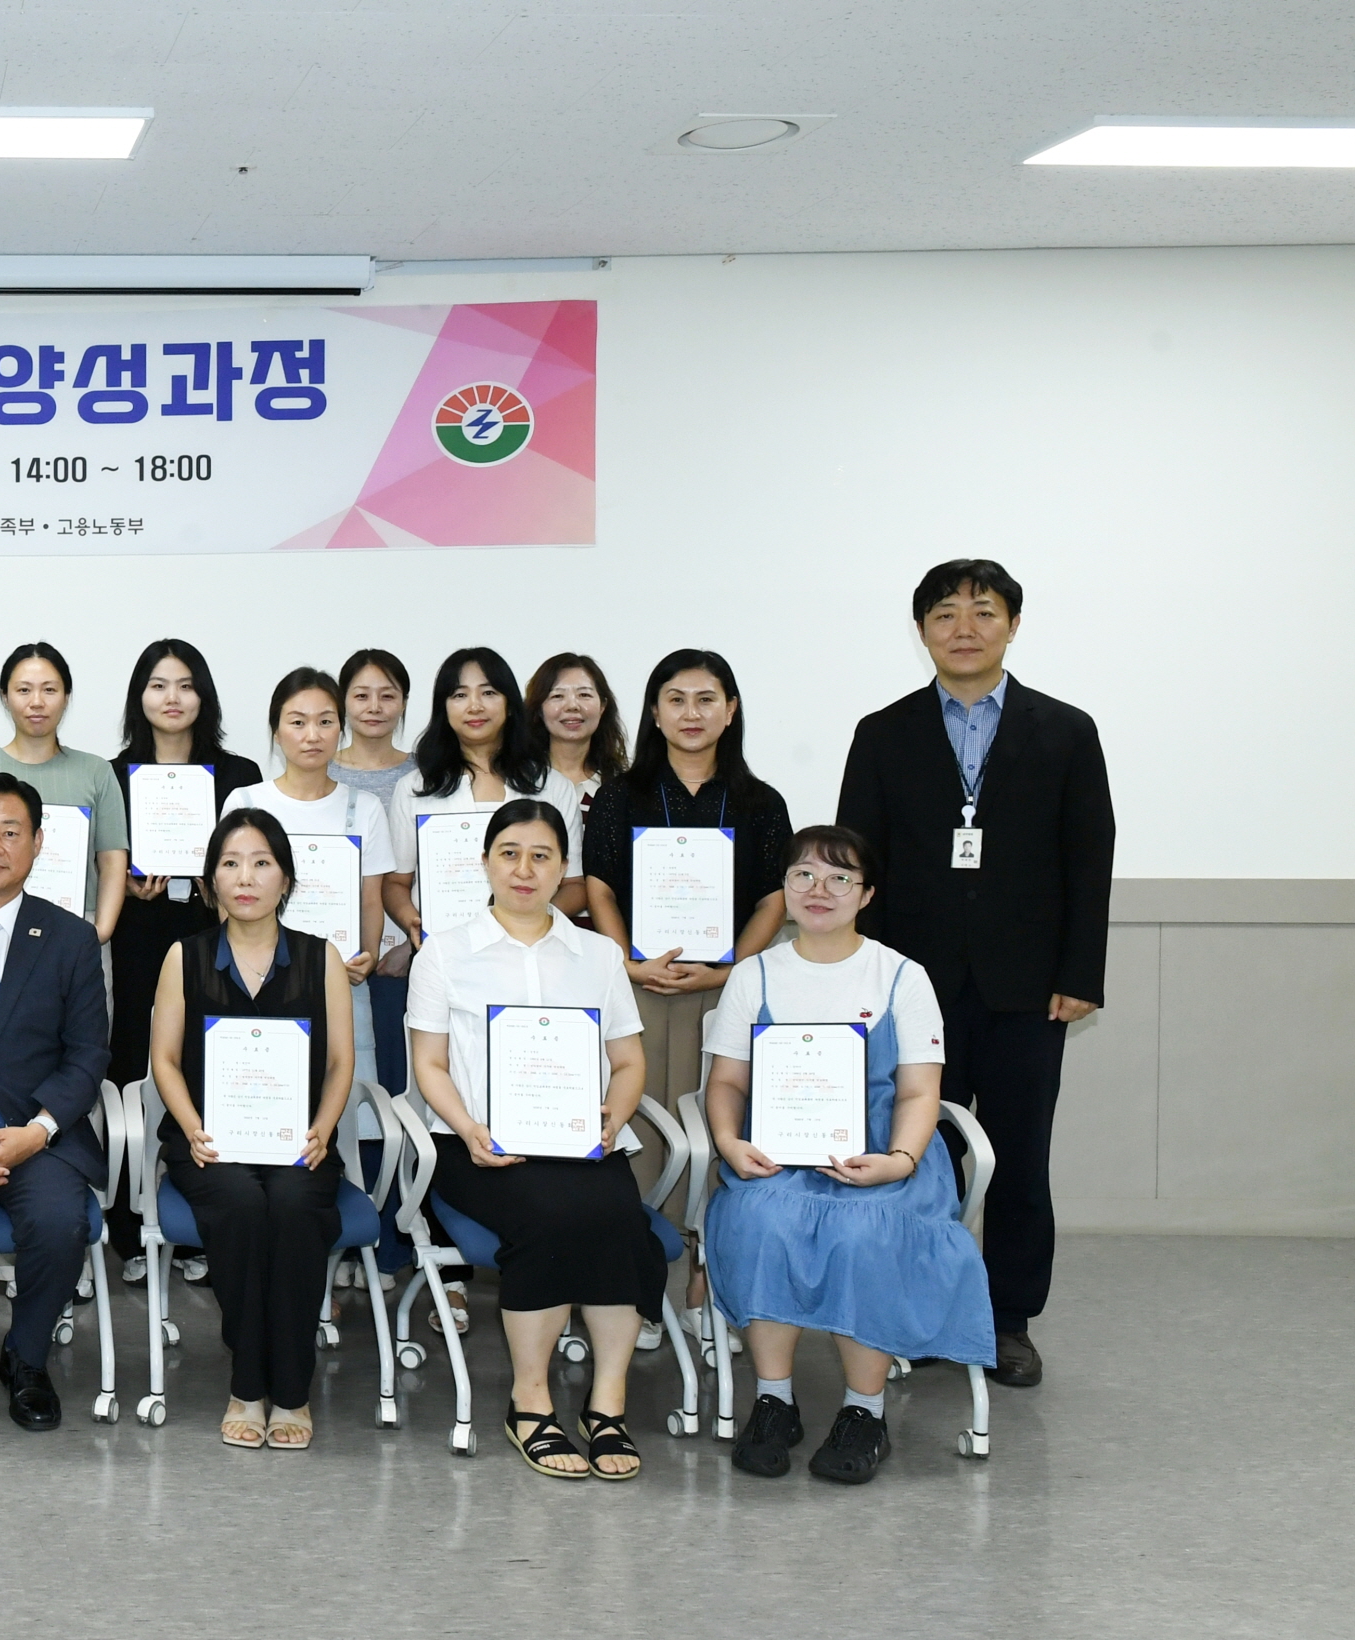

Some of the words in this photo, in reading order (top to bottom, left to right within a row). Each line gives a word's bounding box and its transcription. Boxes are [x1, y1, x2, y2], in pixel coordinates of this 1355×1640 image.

[10, 456, 88, 484] 14:00
[134, 453, 212, 482] 18:00
[56, 517, 144, 537] 고용노동부
